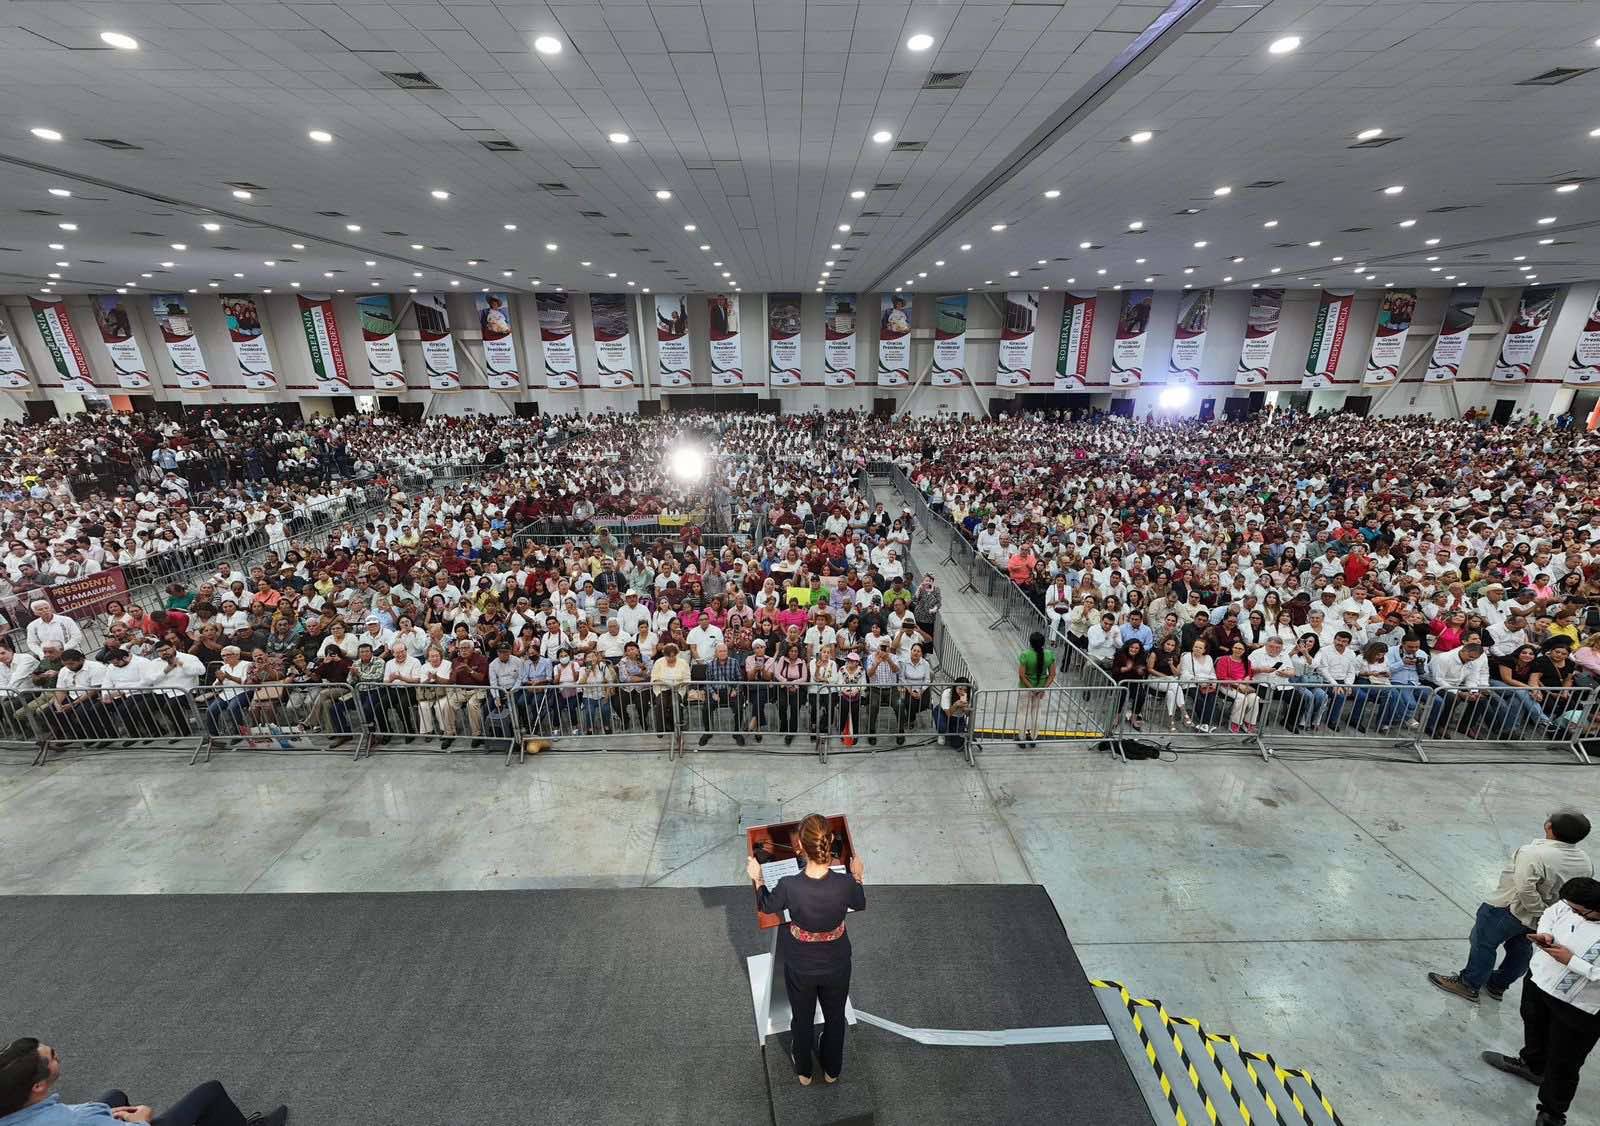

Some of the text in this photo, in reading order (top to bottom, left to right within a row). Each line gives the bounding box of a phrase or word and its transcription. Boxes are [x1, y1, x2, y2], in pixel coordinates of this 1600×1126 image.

[325, 311, 344, 376] INDEPENDENCIA
[1079, 308, 1093, 373] INDEPENDENCIA
[1329, 306, 1348, 370] INDEPENDENCIA
[52, 576, 114, 596] PRESIDENTA
[68, 585, 118, 602] TAMAULIPAS
